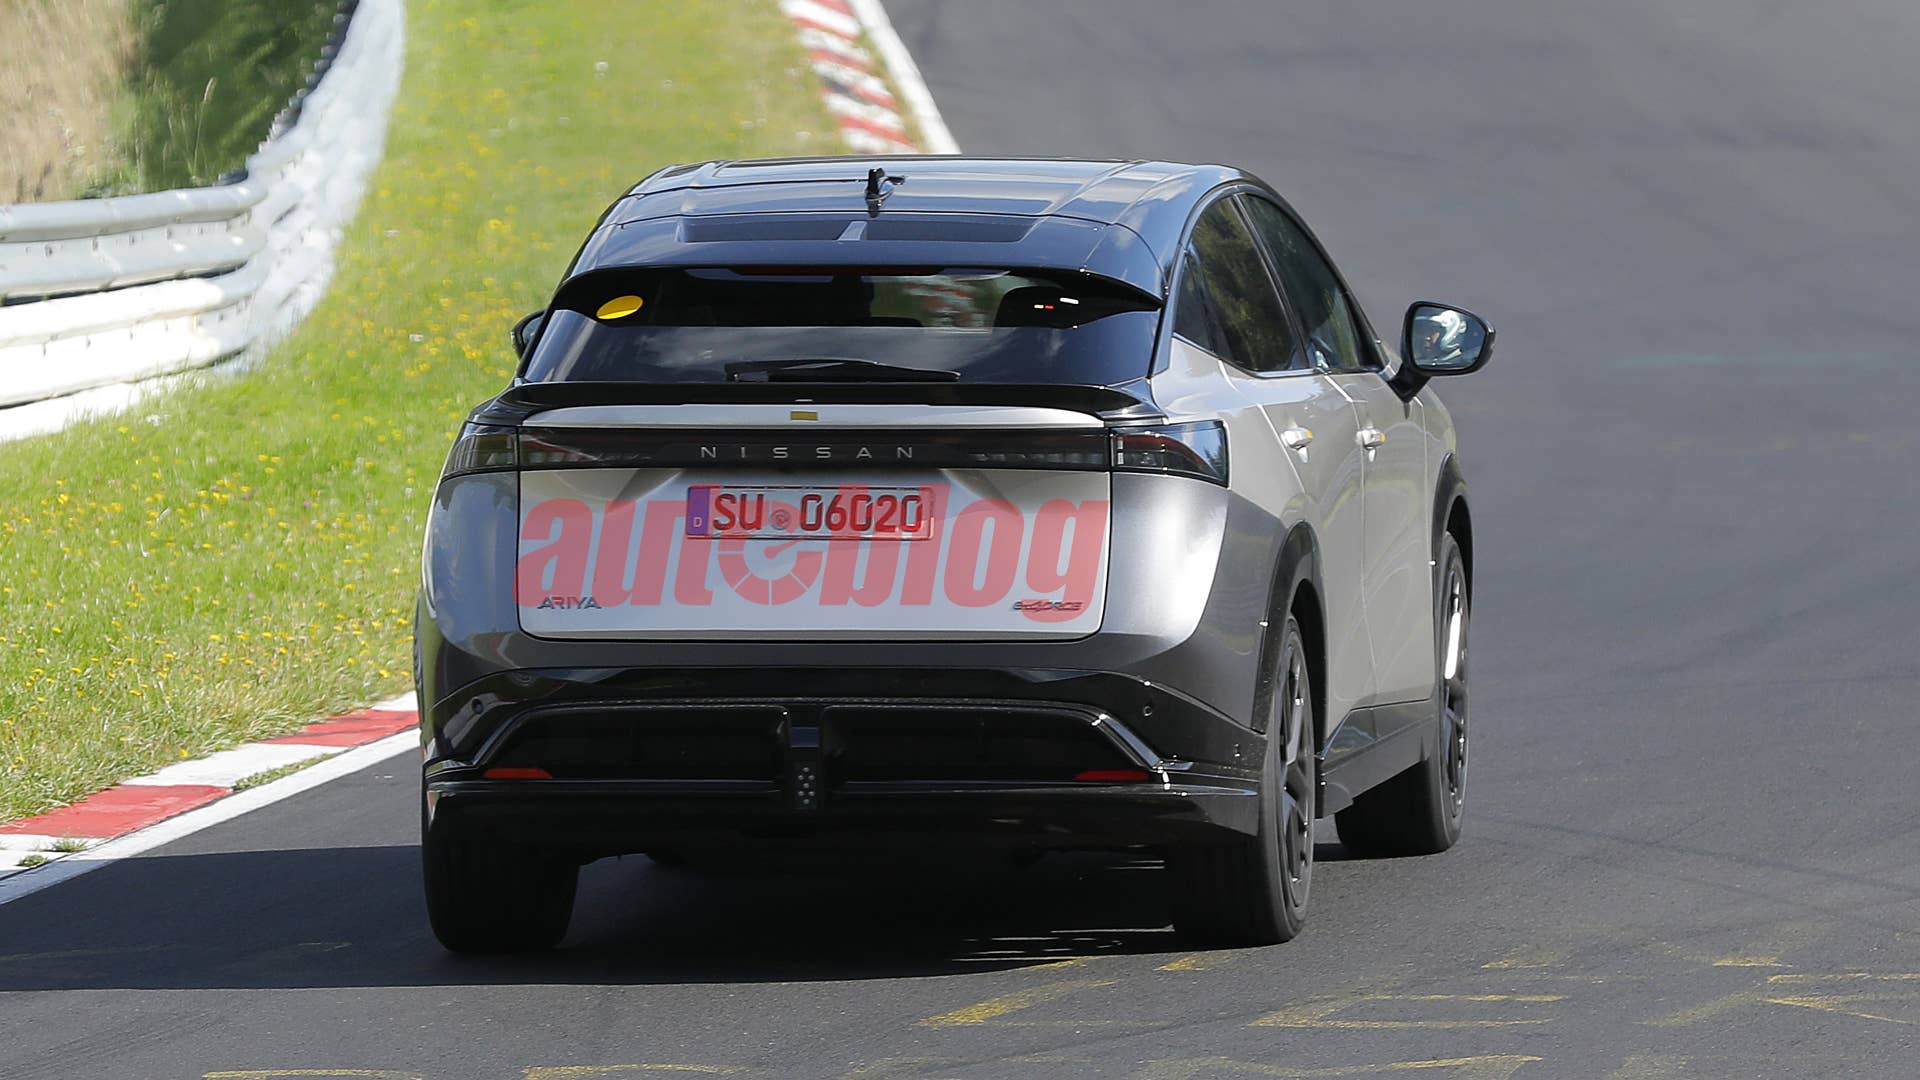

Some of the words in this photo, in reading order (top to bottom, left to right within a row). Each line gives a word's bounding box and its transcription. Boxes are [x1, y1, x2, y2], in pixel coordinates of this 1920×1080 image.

[700, 446, 913, 459] NISSAN
[712, 493, 764, 530] SU
[800, 494, 922, 532] 06020
[692, 517, 703, 528] D
[536, 596, 602, 609] ARIYA
